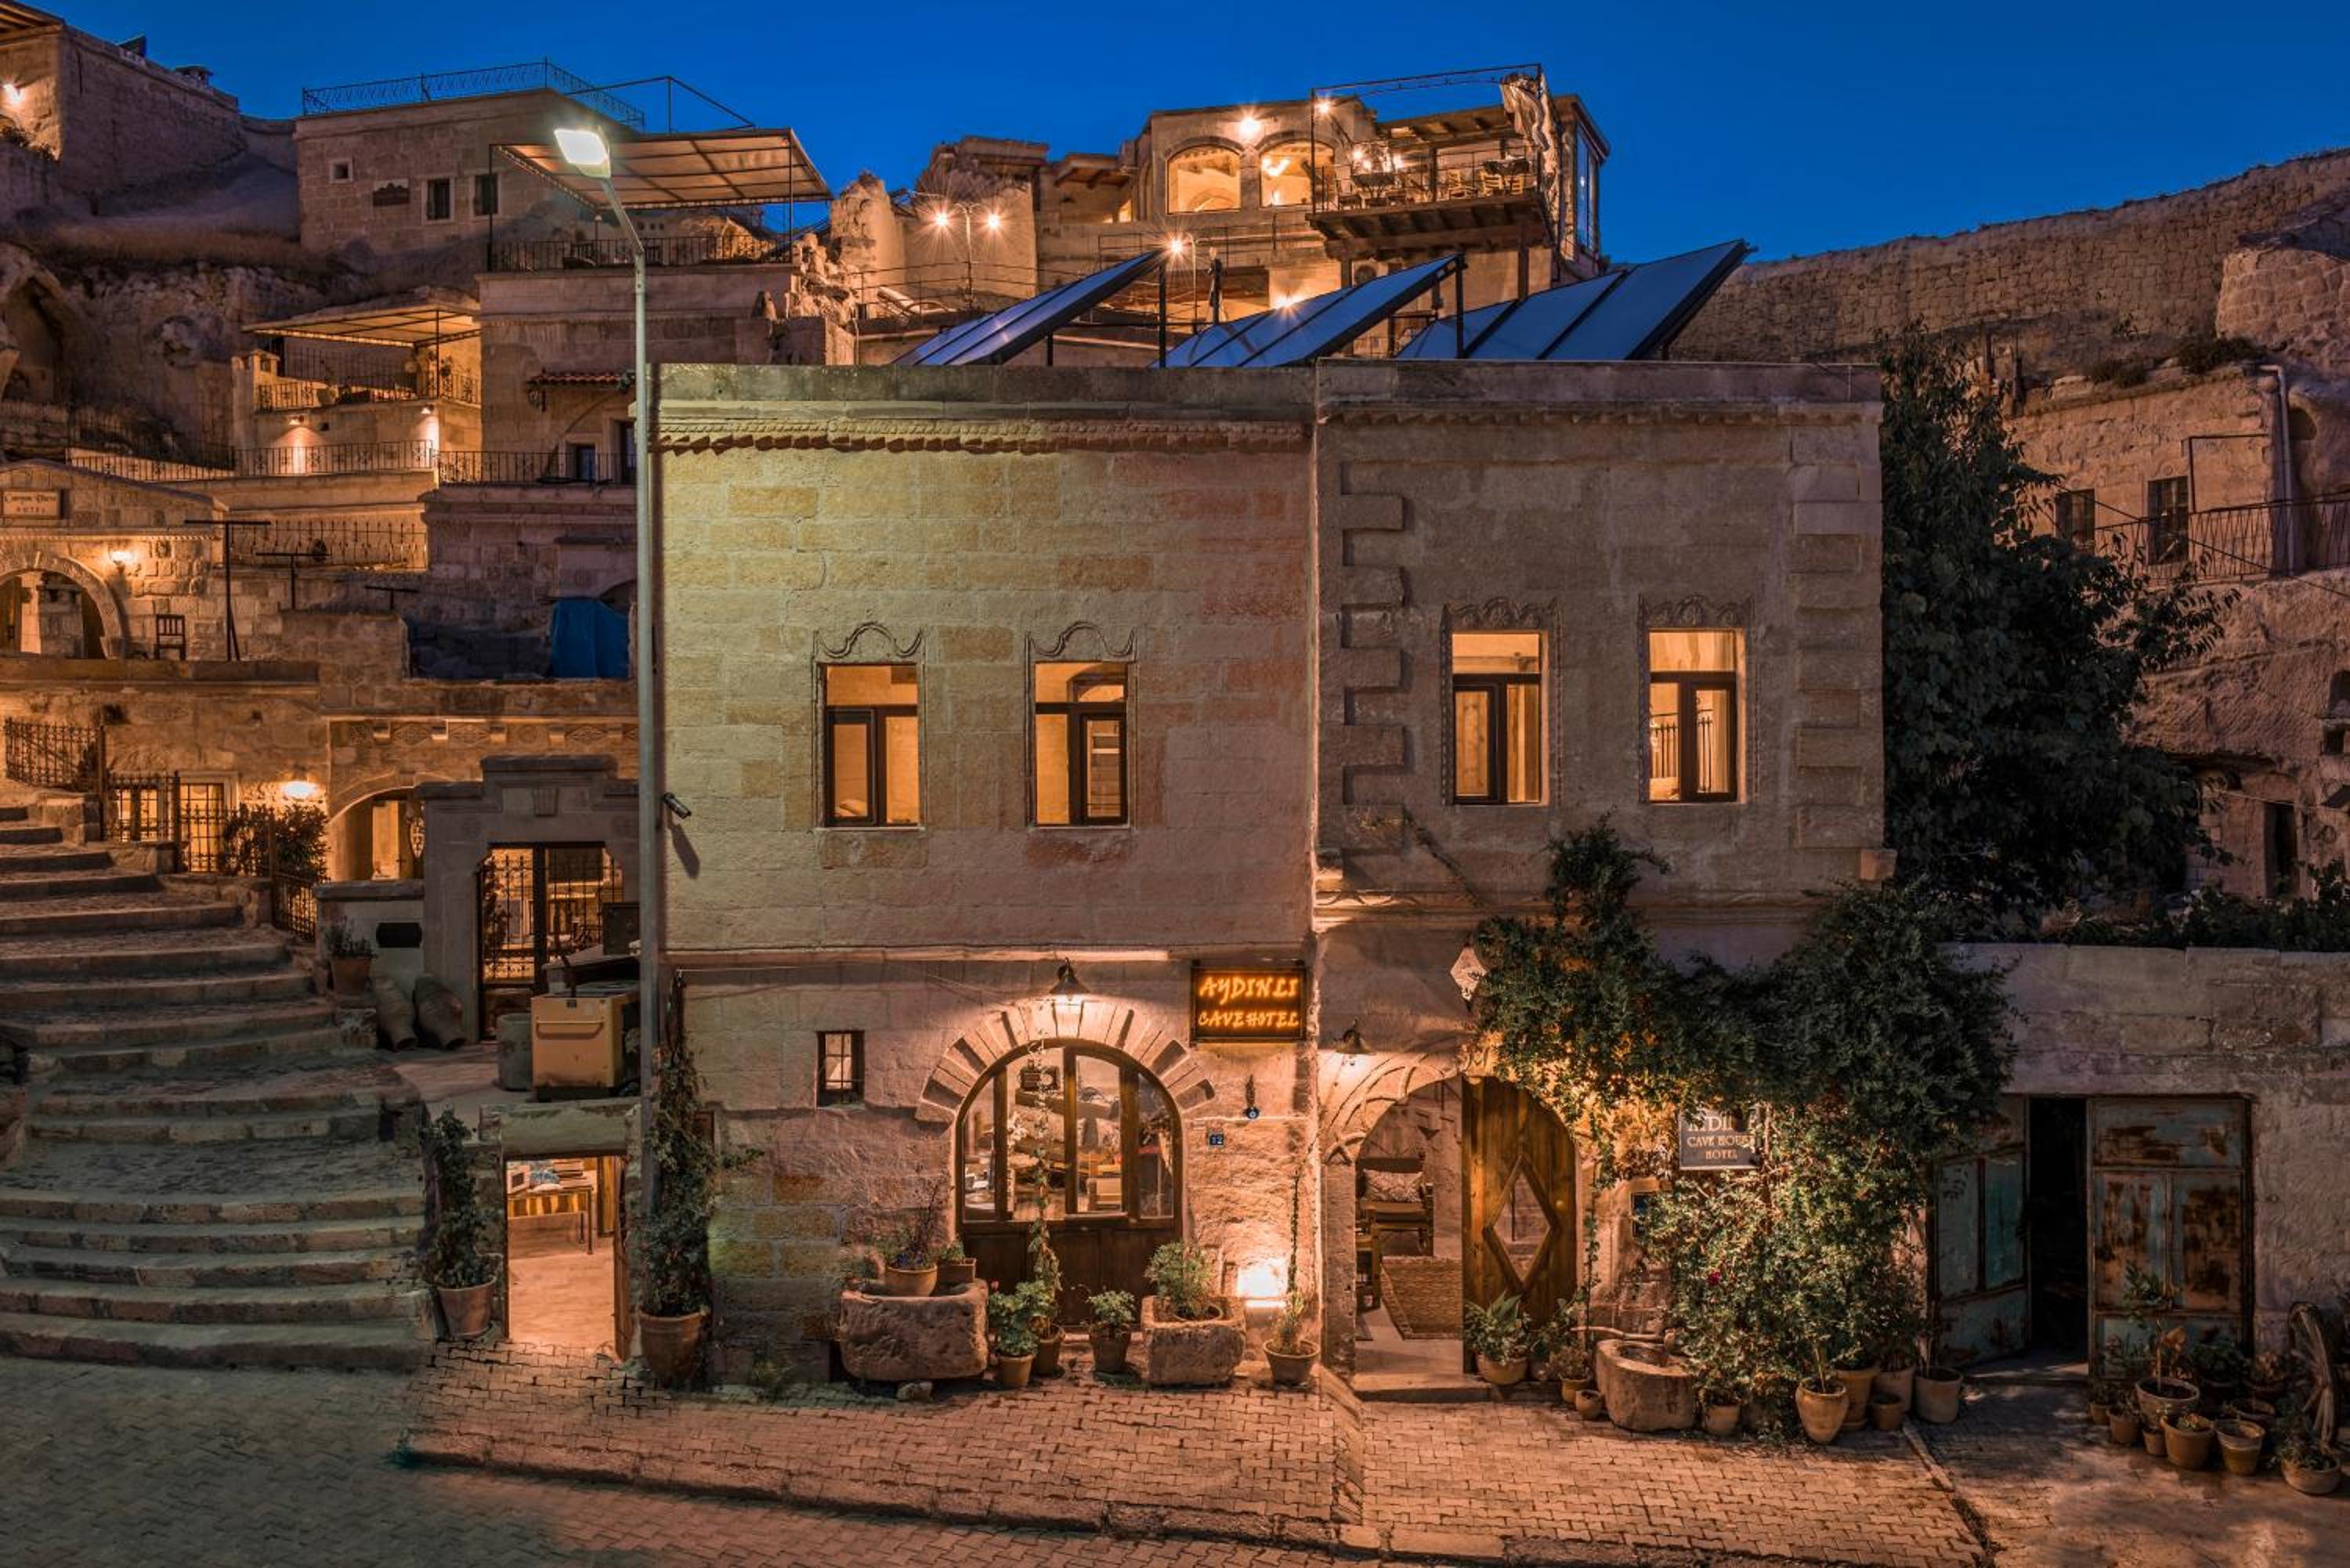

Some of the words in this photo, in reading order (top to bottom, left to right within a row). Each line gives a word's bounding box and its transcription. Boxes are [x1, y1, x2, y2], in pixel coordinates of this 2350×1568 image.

[1198, 976, 1300, 1006] AYDINLI
[1198, 1010, 1245, 1028] CAVE
[1246, 1011, 1300, 1028] HOTEL
[1687, 1136, 1716, 1147] CAVE
[1705, 1149, 1737, 1160] HOTEL
